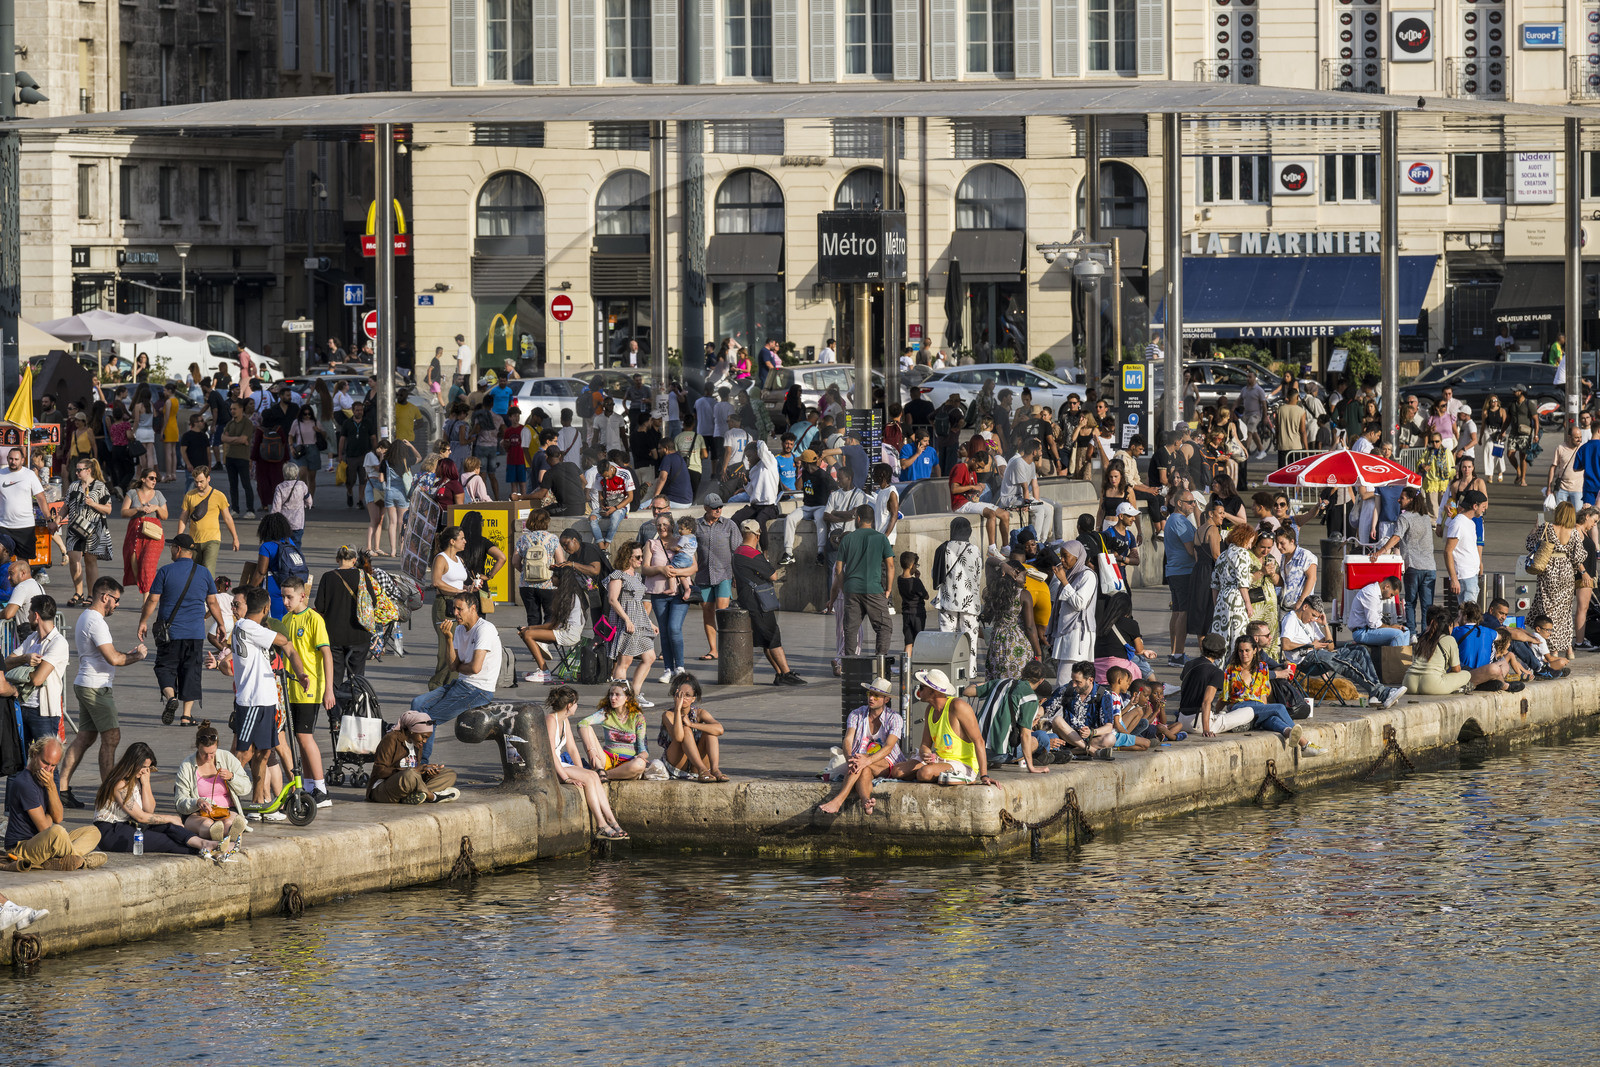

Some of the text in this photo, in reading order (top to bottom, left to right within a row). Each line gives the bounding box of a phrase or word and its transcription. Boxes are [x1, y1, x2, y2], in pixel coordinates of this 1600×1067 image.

[1411, 170, 1429, 178] RFM
[822, 231, 906, 256] Métro Métro
[1190, 231, 1381, 254] LA MARINIER
[75, 252, 86, 263] IT
[1532, 313, 1552, 321] PLAISIR
[1239, 326, 1334, 337] LA MARINIERE
[1126, 374, 1142, 385] M1
[487, 519, 498, 527] TRI
